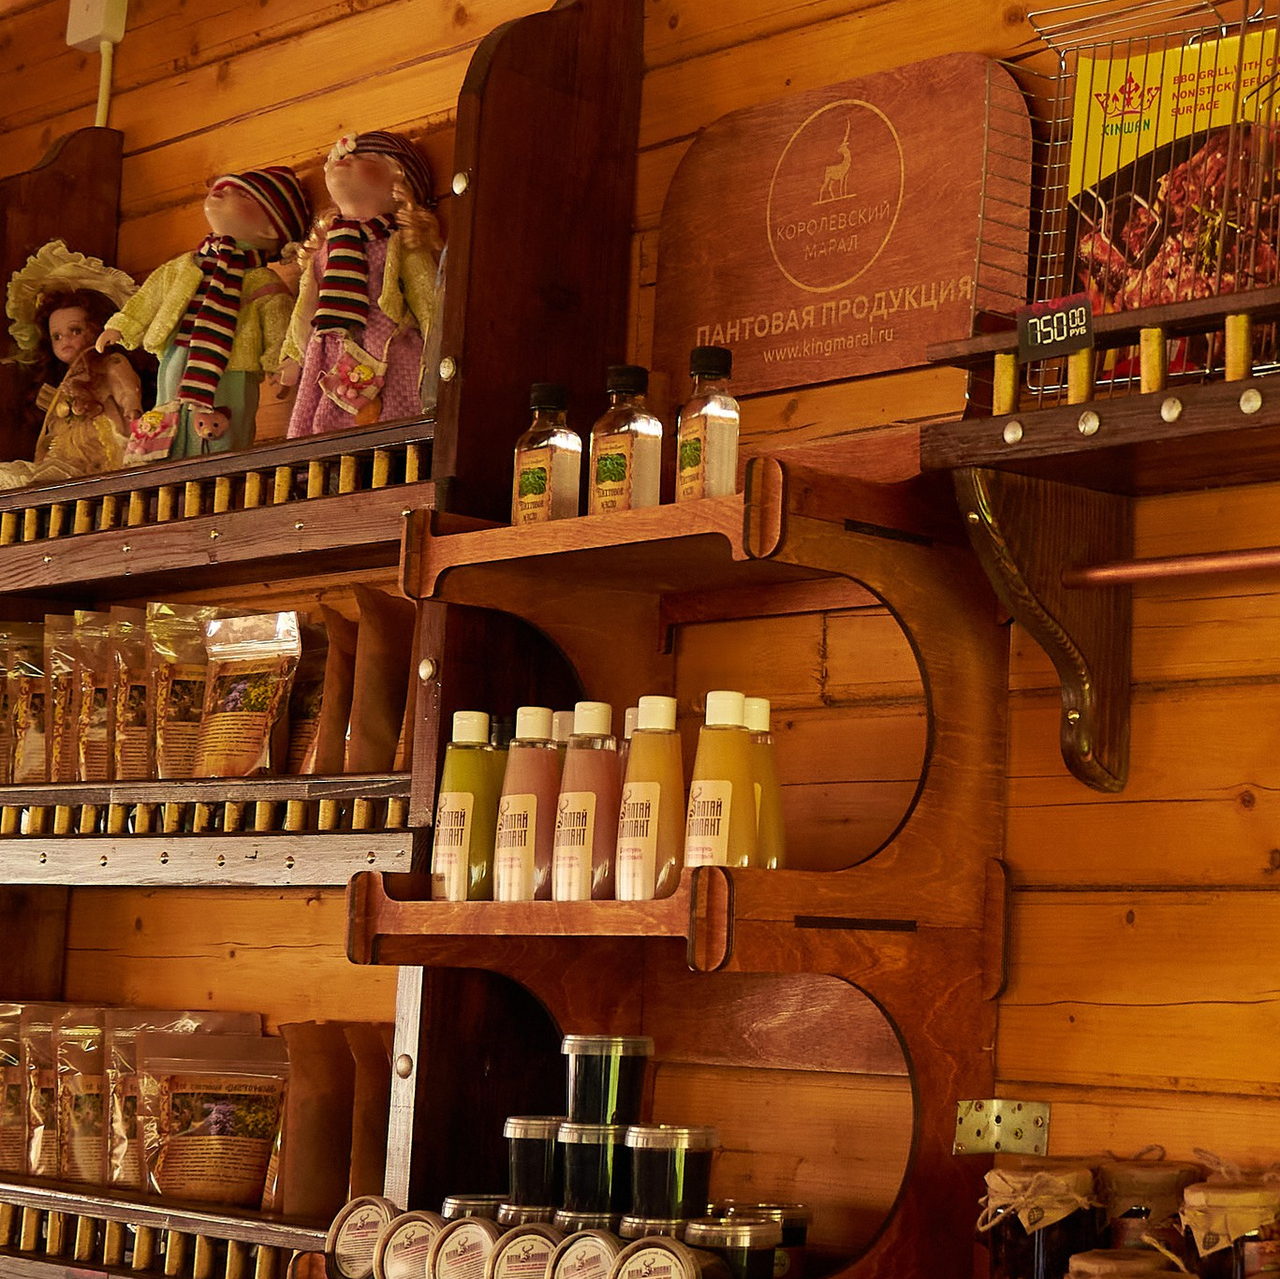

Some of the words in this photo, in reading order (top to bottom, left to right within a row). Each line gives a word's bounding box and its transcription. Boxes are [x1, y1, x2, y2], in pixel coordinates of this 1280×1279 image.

[776, 199, 891, 241] КОРОЛЕВСКИЙ
[804, 233, 859, 261] МАРАЛ
[697, 305, 816, 347] ПАНТОВАЯ
[822, 274, 973, 326] ПРОДУКЦИЯ
[763, 326, 895, 363] www.kingmaral.ru
[1028, 313, 1067, 345] 750
[1069, 326, 1087, 337] РУБ
